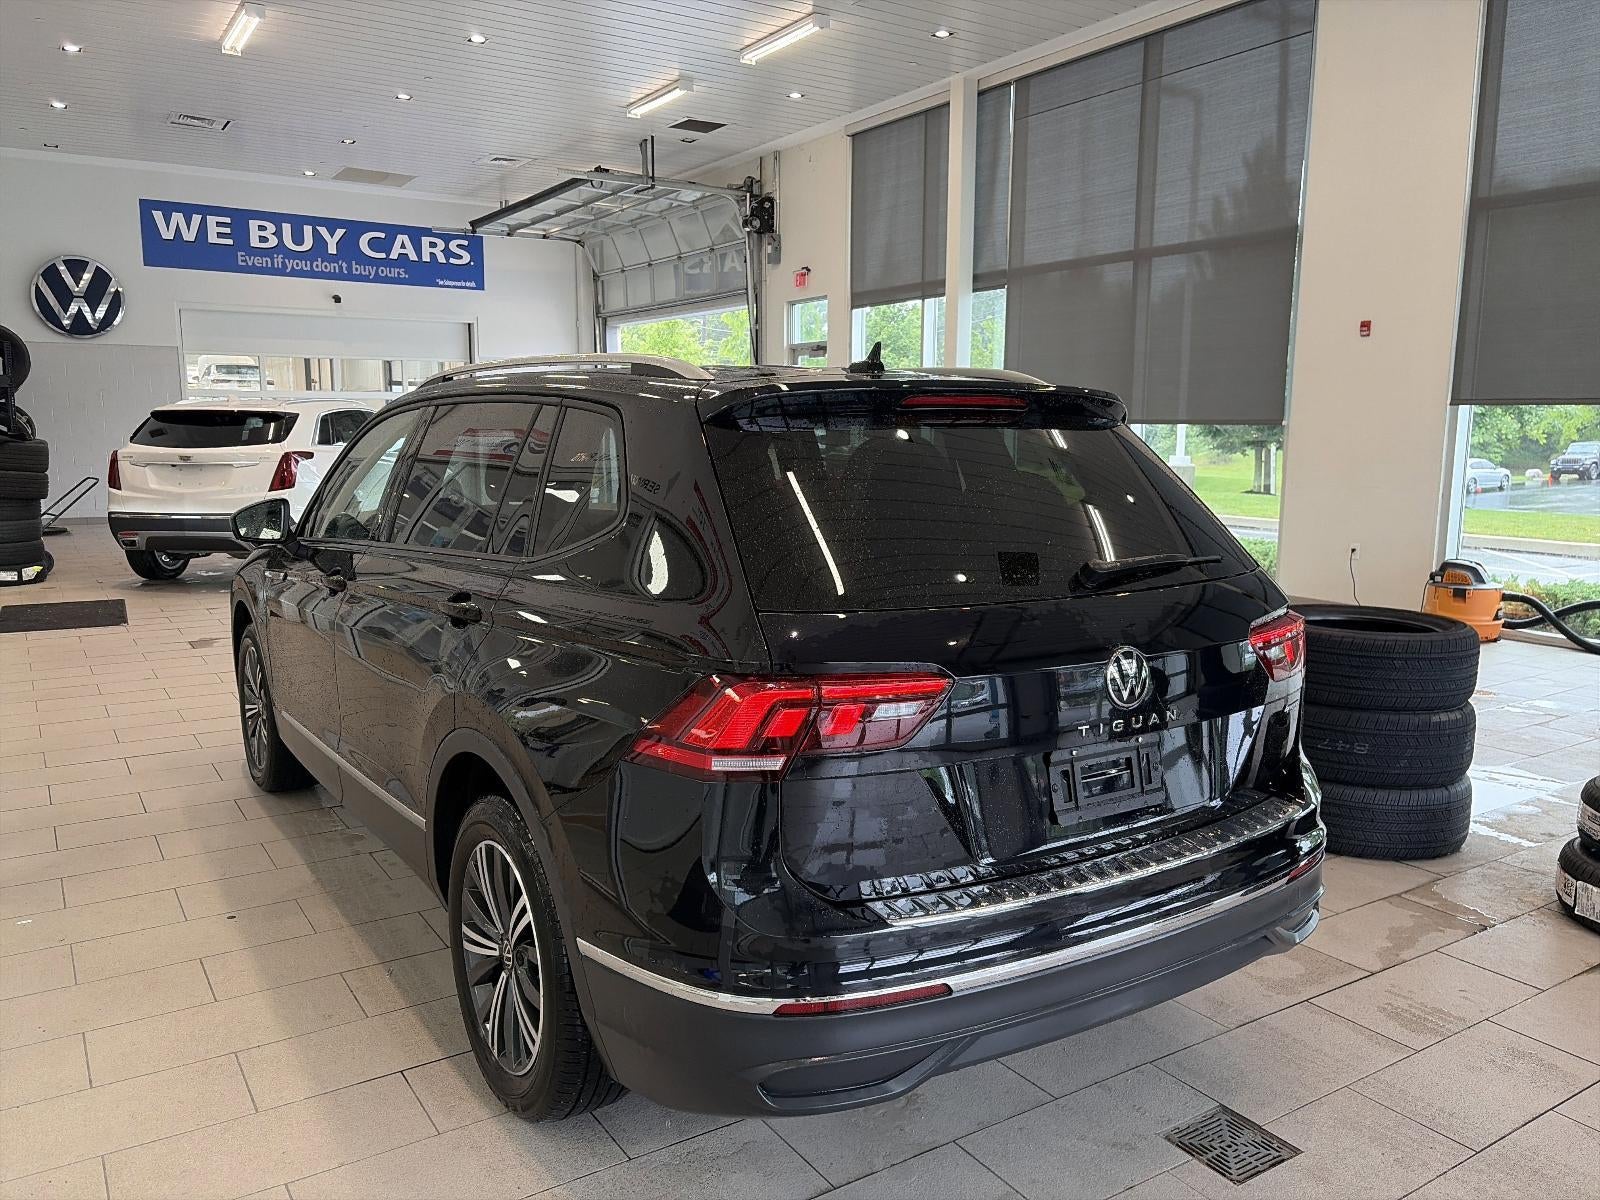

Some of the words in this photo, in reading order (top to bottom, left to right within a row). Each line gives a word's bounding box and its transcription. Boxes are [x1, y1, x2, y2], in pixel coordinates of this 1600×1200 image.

[152, 209, 234, 246] WE
[248, 219, 347, 255] BUY
[359, 231, 475, 266] CARS.
[237, 251, 271, 268] Even
[274, 253, 284, 269] if
[284, 258, 311, 273] you
[312, 257, 348, 275] don't
[352, 260, 377, 280] buy
[378, 266, 409, 279] ours.
[1077, 709, 1177, 737] TIGUAN
